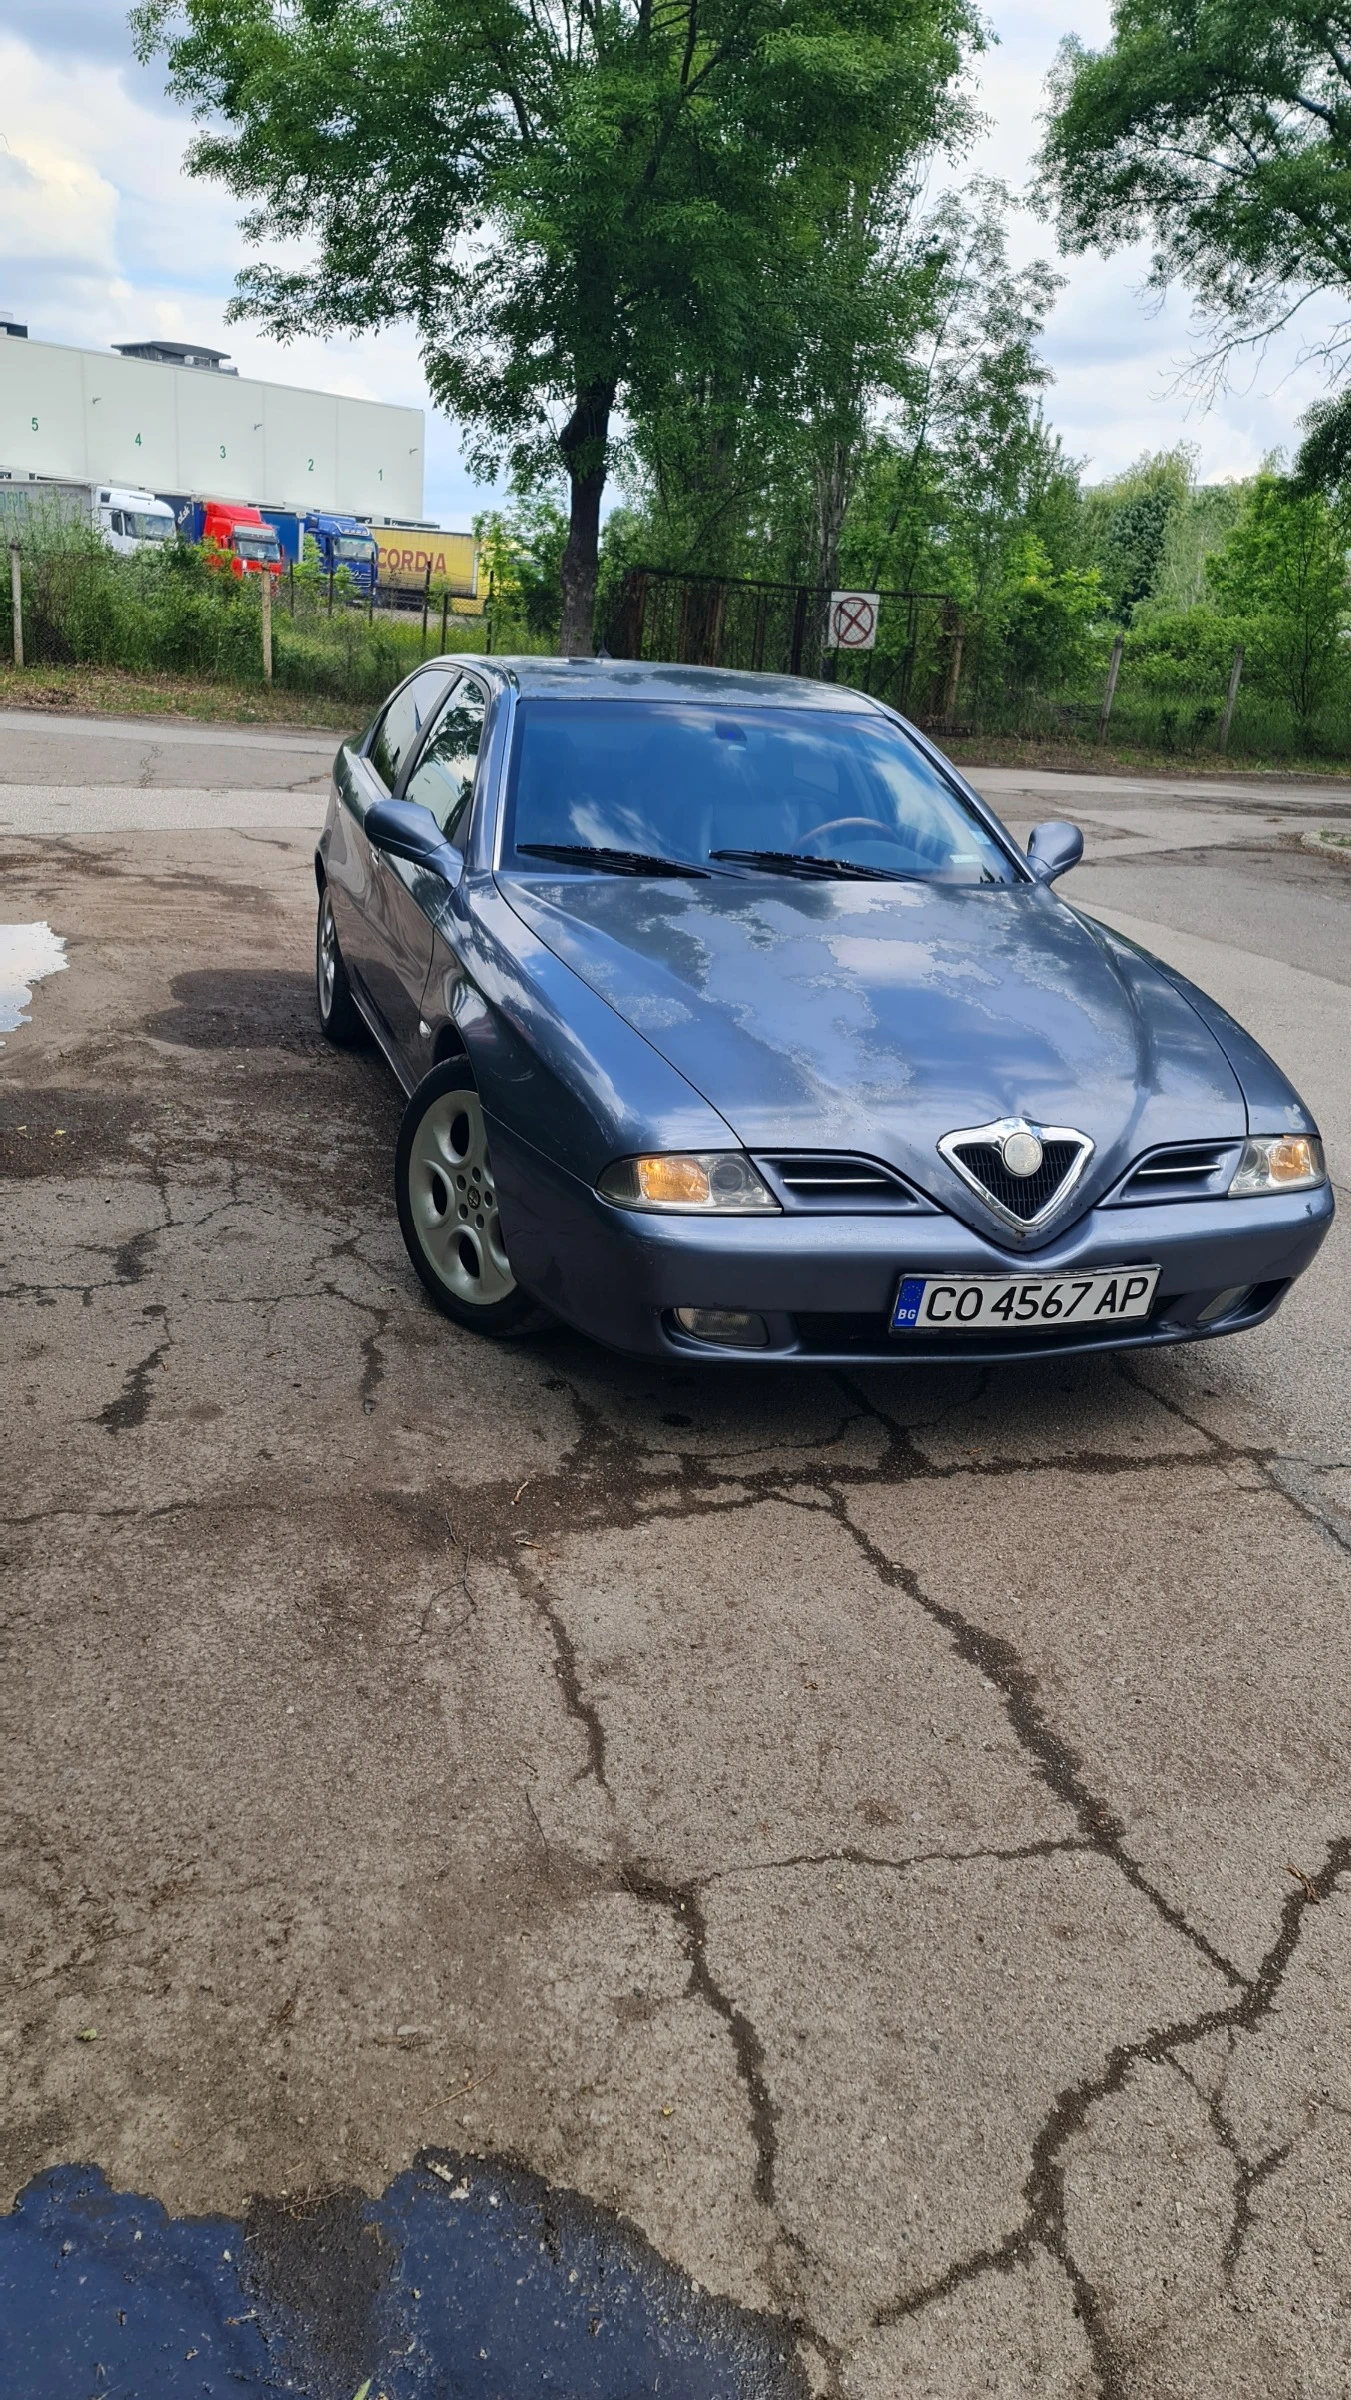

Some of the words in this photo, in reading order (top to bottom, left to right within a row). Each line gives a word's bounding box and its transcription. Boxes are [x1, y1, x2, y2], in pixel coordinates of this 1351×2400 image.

[31, 417, 39, 432] 5
[134, 433, 142, 447] 4
[219, 446, 227, 459] 3
[308, 459, 315, 472] 2
[378, 469, 383, 482] 1
[377, 547, 447, 575] CORDIA
[926, 1286, 984, 1321] CO
[990, 1281, 1094, 1321] 4567
[1093, 1276, 1149, 1315] AP
[898, 1309, 917, 1320] BG
